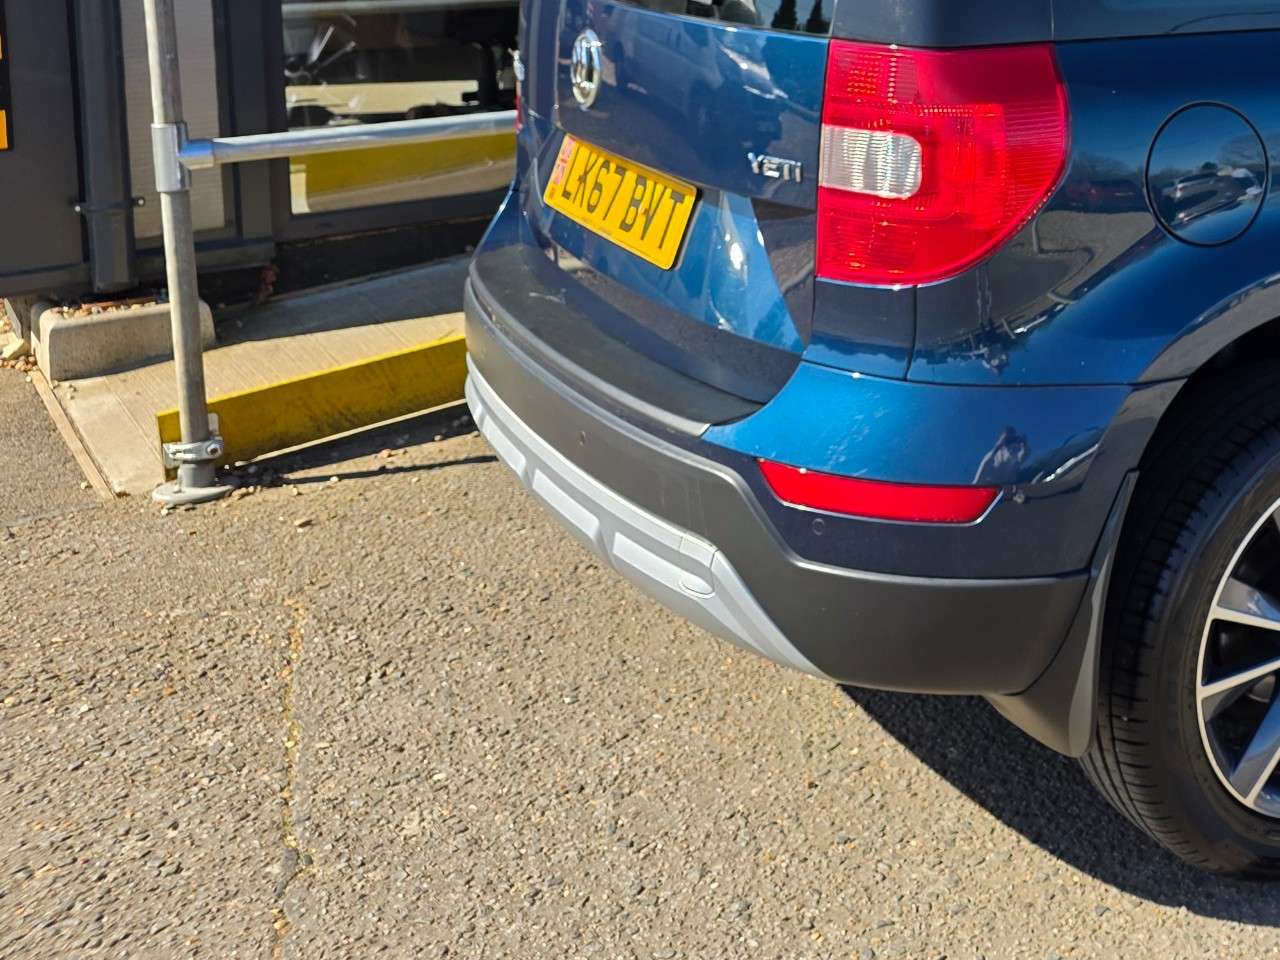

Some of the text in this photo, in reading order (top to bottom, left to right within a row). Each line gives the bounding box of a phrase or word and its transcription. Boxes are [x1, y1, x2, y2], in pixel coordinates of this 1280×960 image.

[561, 142, 685, 250] LK67 BVT
[747, 152, 802, 183] YETI
